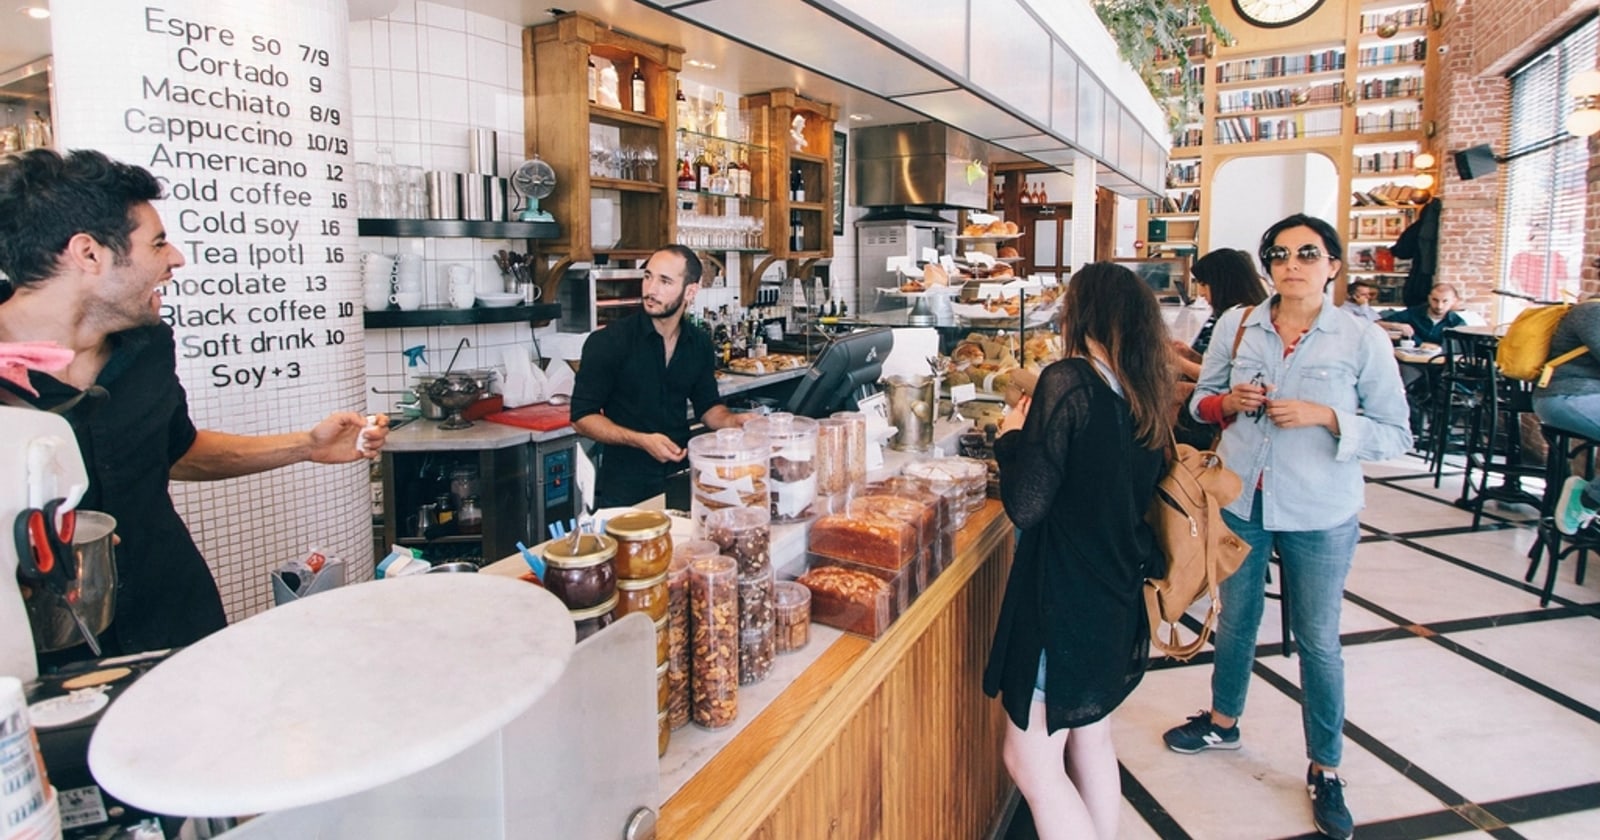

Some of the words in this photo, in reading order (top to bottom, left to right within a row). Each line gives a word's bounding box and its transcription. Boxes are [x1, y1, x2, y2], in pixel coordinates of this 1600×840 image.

[177, 46, 289, 88] Cortado
[308, 75, 322, 94] 9
[298, 44, 330, 68] 7/9
[142, 75, 291, 118] Macchiato
[309, 105, 341, 126] 8/9
[124, 108, 293, 148] Cappuccino
[307, 133, 349, 156] 10/13
[149, 142, 308, 179] Americano
[326, 163, 344, 183] 12
[229, 181, 312, 208] coffee
[331, 191, 348, 210] 16
[179, 208, 247, 235] Cold
[254, 217, 300, 242] soy
[320, 219, 341, 237] 16
[184, 240, 239, 265] Tea
[248, 243, 304, 271] (pot)
[325, 246, 345, 264] 16
[159, 272, 287, 297] hocolate
[305, 275, 328, 293] 13
[247, 299, 327, 324] coffee
[337, 301, 354, 319] 10
[182, 332, 243, 359] Soft
[250, 327, 316, 354] drink
[325, 328, 345, 347] 10
